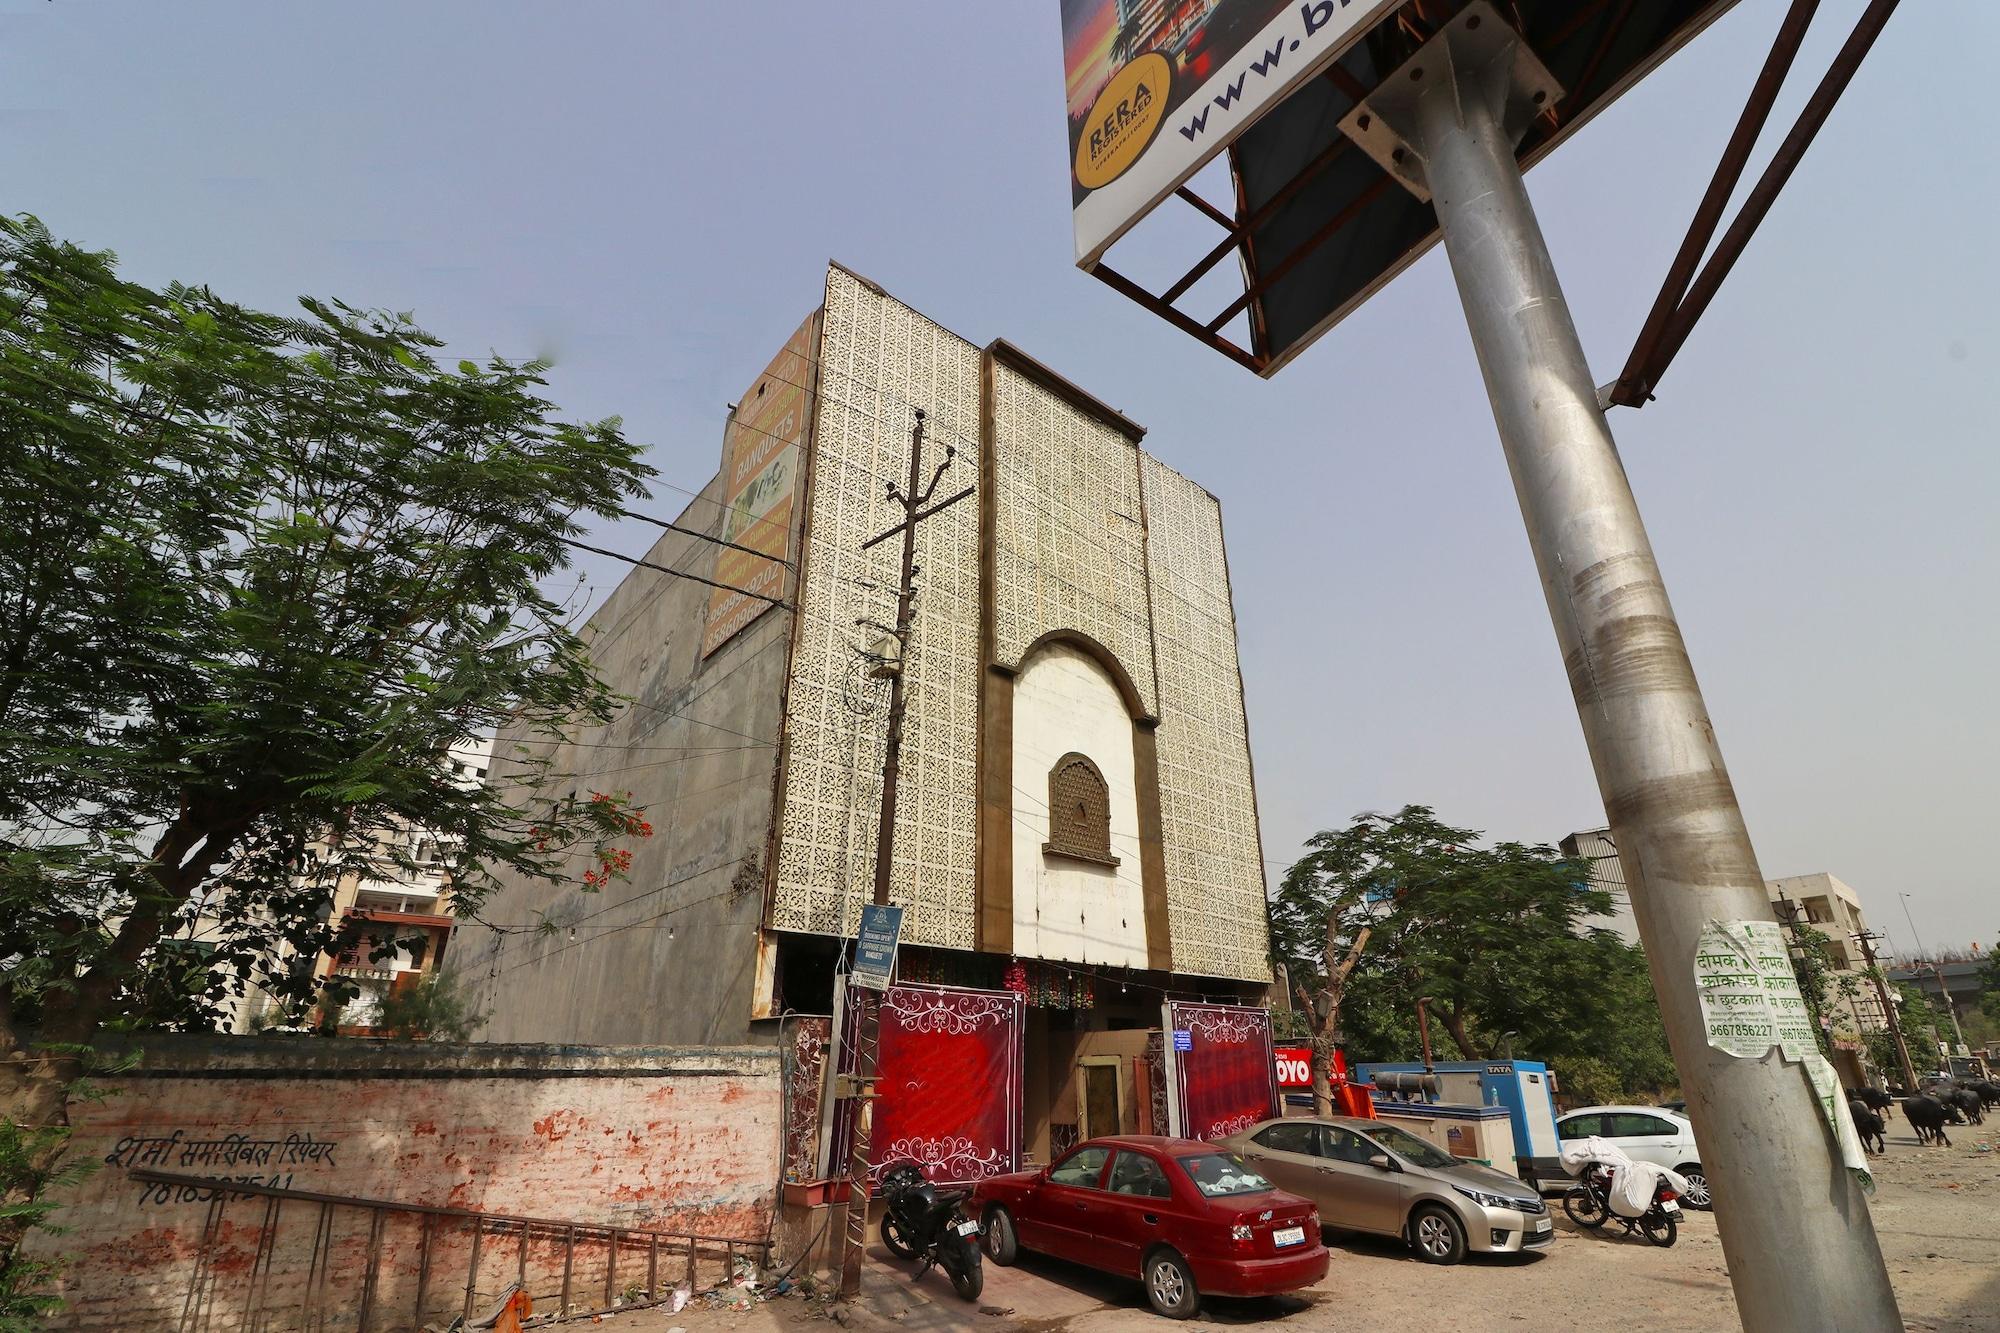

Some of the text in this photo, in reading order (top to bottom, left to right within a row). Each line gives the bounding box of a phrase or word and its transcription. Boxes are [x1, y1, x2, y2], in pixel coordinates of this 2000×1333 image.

[1090, 82, 1151, 153] RERA
[1091, 94, 1152, 162] REGISTERED
[736, 409, 794, 484] BANQUETS
[1696, 950, 1738, 971] दीमक
[1704, 991, 1764, 1010] से छुटकारा
[1710, 1024, 1773, 1037] 9667856227
[1276, 1060, 1310, 1083] OYO
[1487, 1066, 1512, 1074] TATA
[104, 1130, 183, 1169] शर्मा
[278, 1132, 339, 1168] रिपेयर
